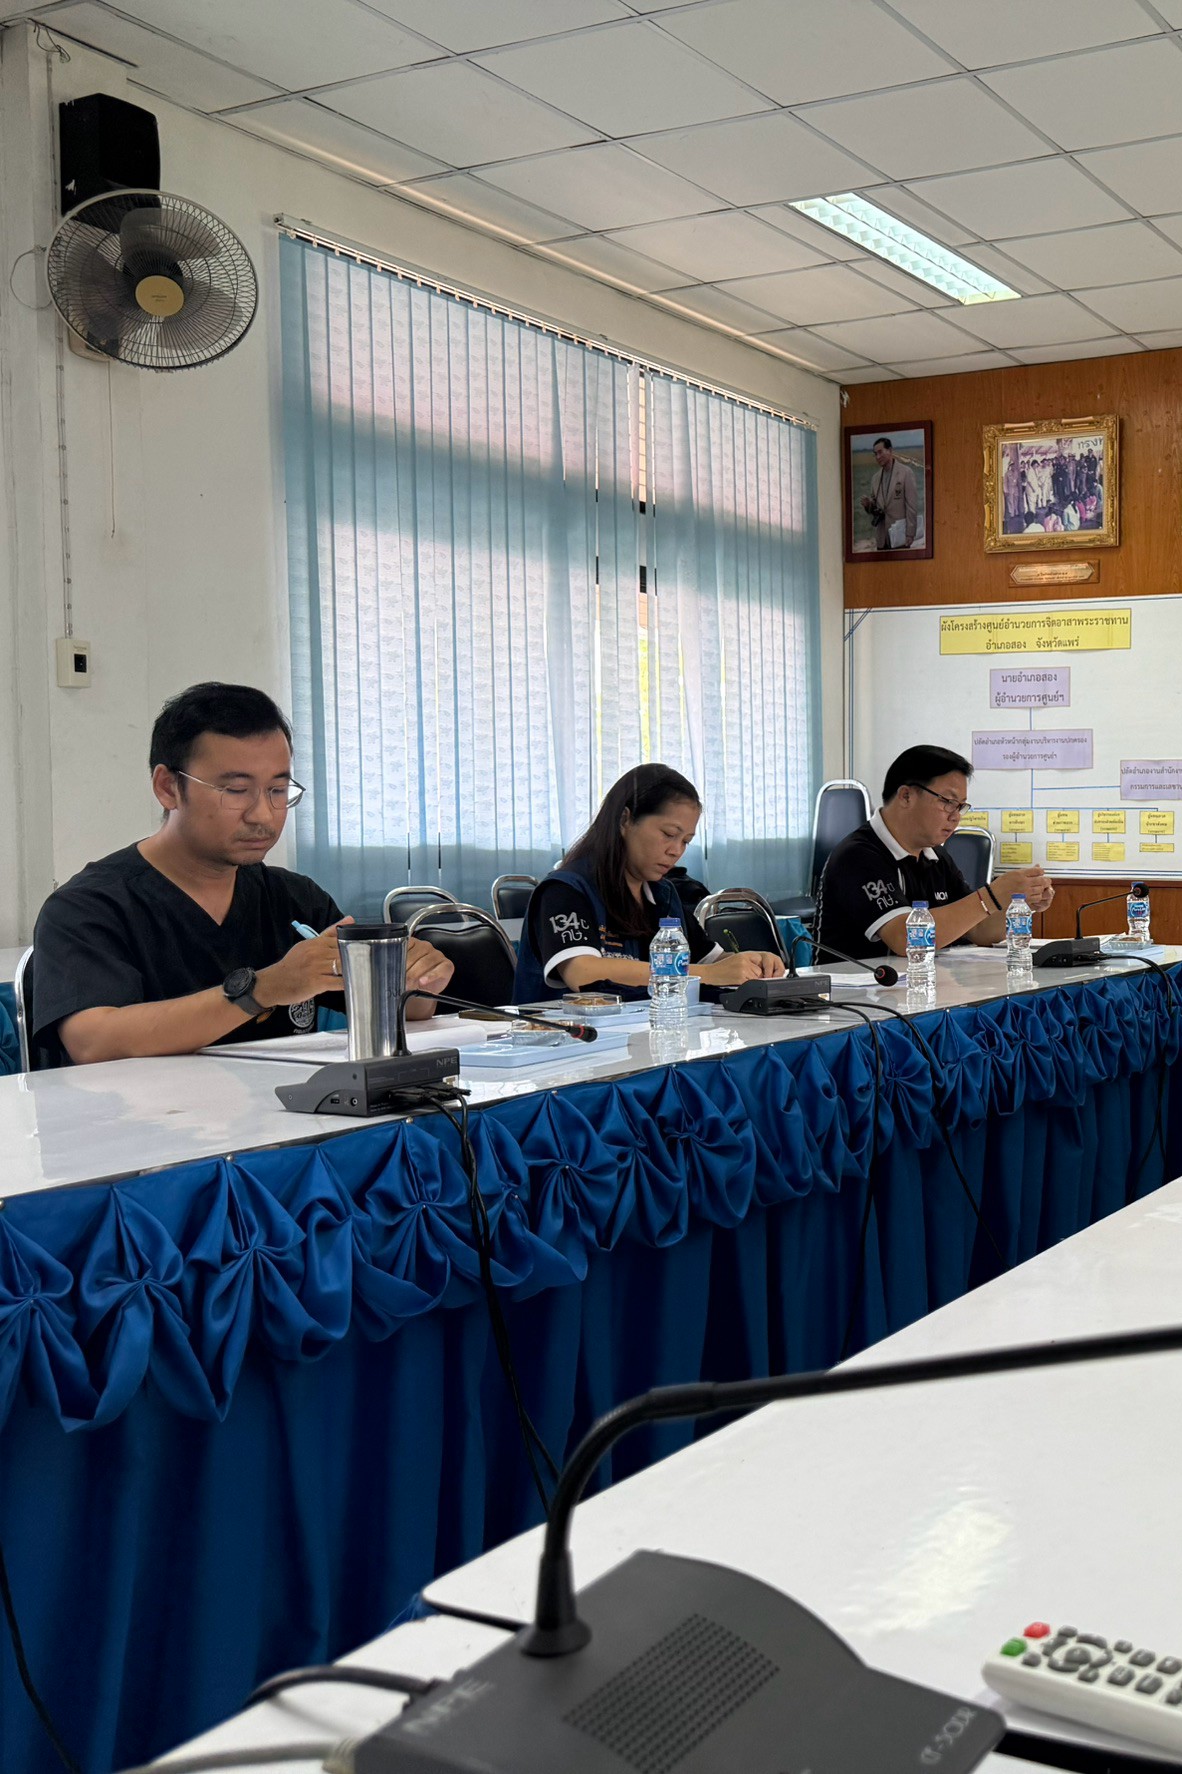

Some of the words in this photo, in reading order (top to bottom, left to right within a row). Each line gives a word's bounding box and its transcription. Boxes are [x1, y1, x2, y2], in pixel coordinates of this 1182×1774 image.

[941, 616, 1129, 634] ผังโครงสร้างศูนย์อำนวยการจิตอาสาพระราชทาน
[985, 640, 1027, 651] อำเภอสอง
[1035, 636, 1080, 650] จังหวัดแพร่
[1001, 673, 1058, 683] นายอำเภอสอง
[995, 690, 1065, 707] ผู้อำนวยการศูนย์ฯ
[436, 1056, 458, 1067] NPE
